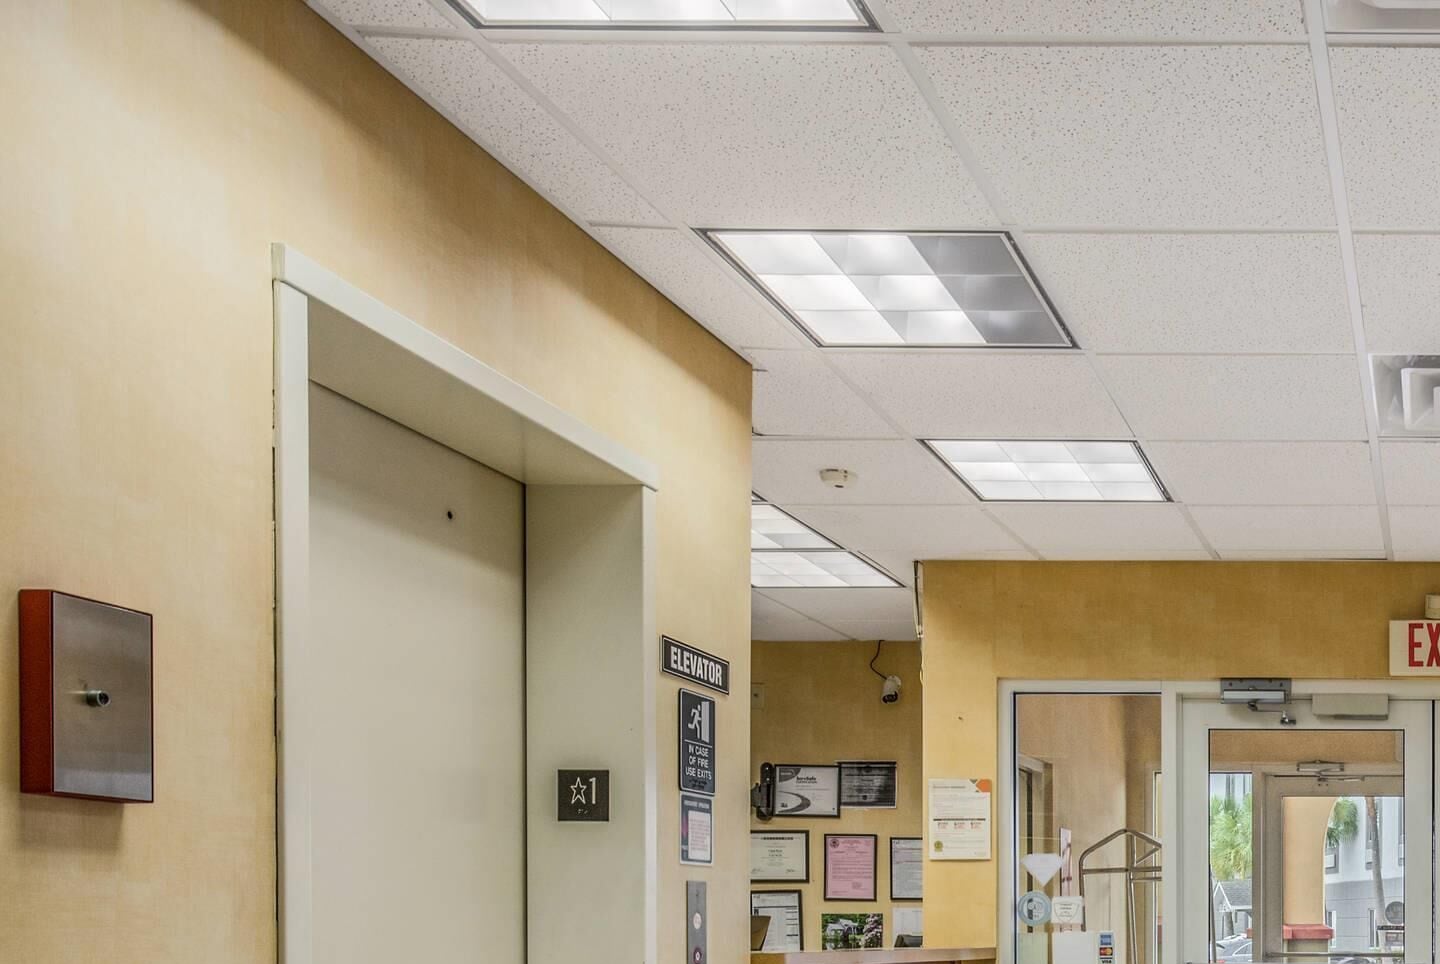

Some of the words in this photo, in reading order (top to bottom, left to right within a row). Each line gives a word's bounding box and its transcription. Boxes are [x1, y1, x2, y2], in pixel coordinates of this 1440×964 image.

[670, 646, 723, 686] ELEVATOR
[688, 744, 694, 754] IN
[695, 746, 709, 757] CASE
[688, 755, 696, 765] OF
[697, 757, 709, 768] FIRE
[685, 766, 696, 777] USE
[697, 769, 712, 780] EXITS
[589, 777, 596, 805] 1
